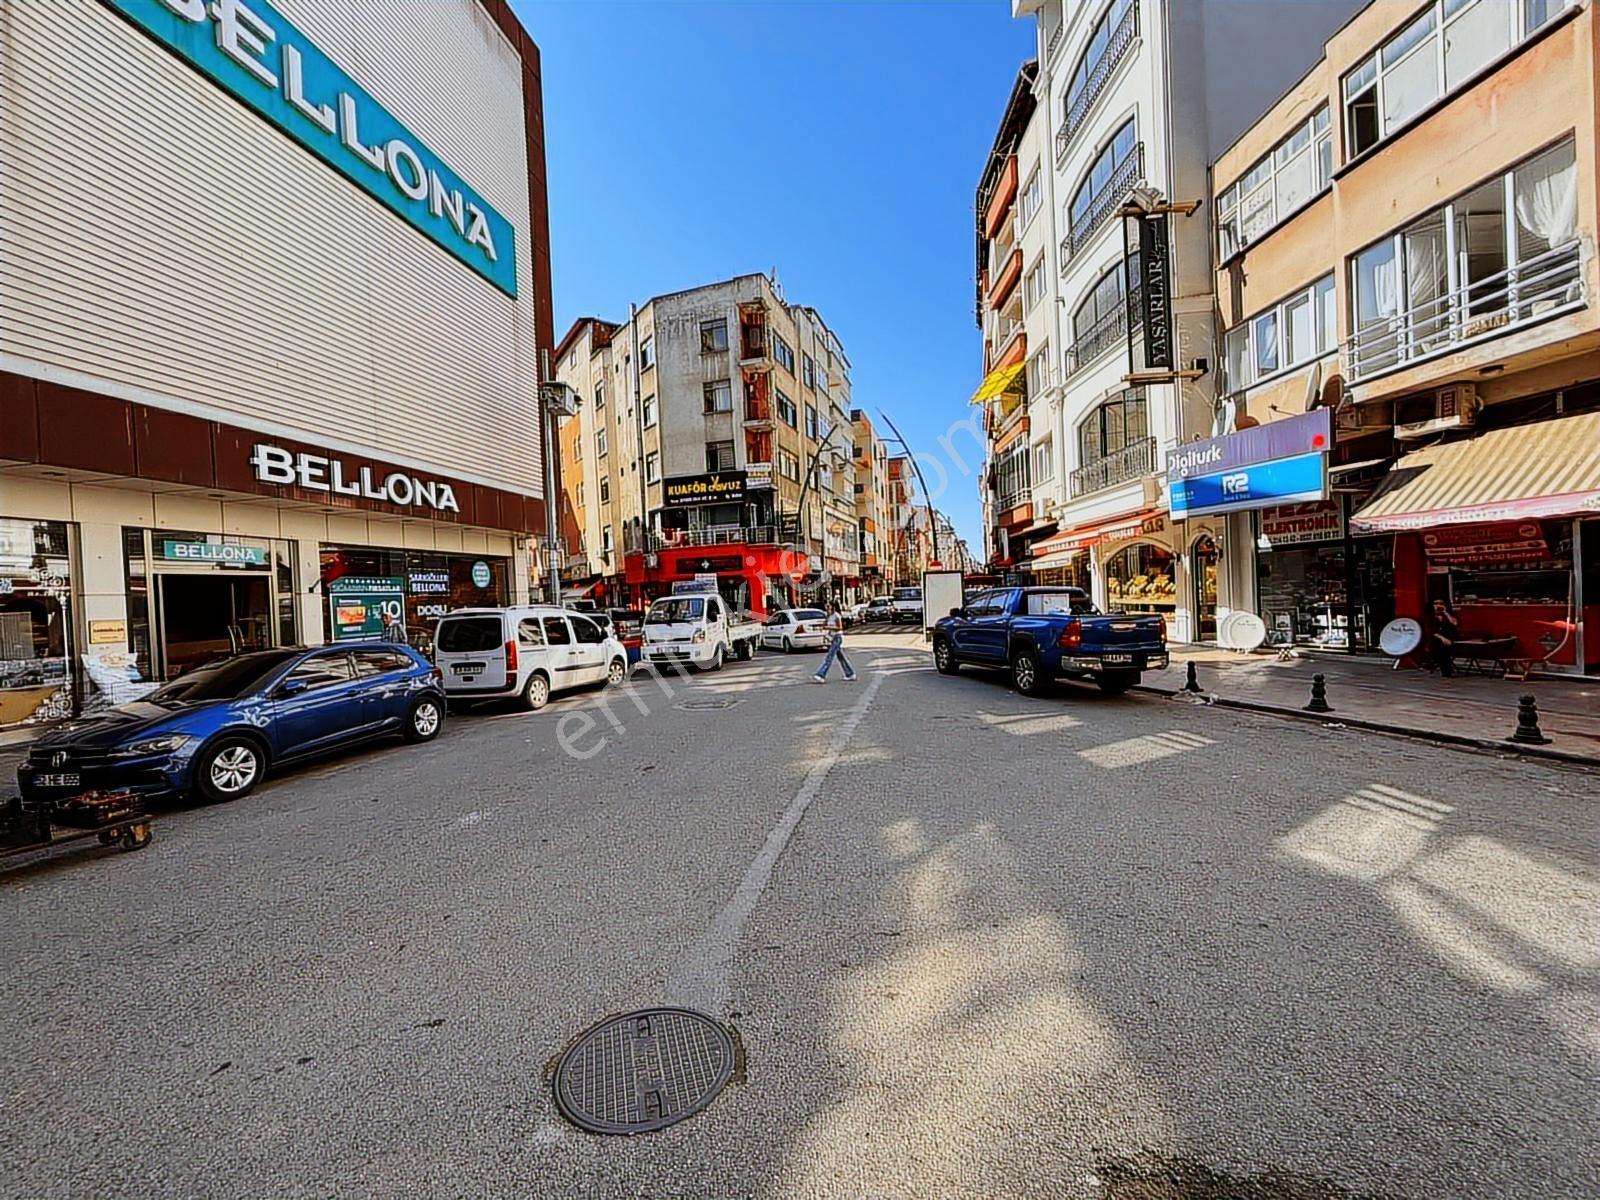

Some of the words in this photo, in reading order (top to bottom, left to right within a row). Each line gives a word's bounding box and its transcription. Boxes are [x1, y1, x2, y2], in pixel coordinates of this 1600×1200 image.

[163, 0, 497, 262] ELLONA
[1147, 258, 1167, 366] YAŞARLAR
[250, 444, 460, 512] BELLONA
[667, 481, 707, 496] KUAFÖR
[174, 544, 256, 560] BELLONA
